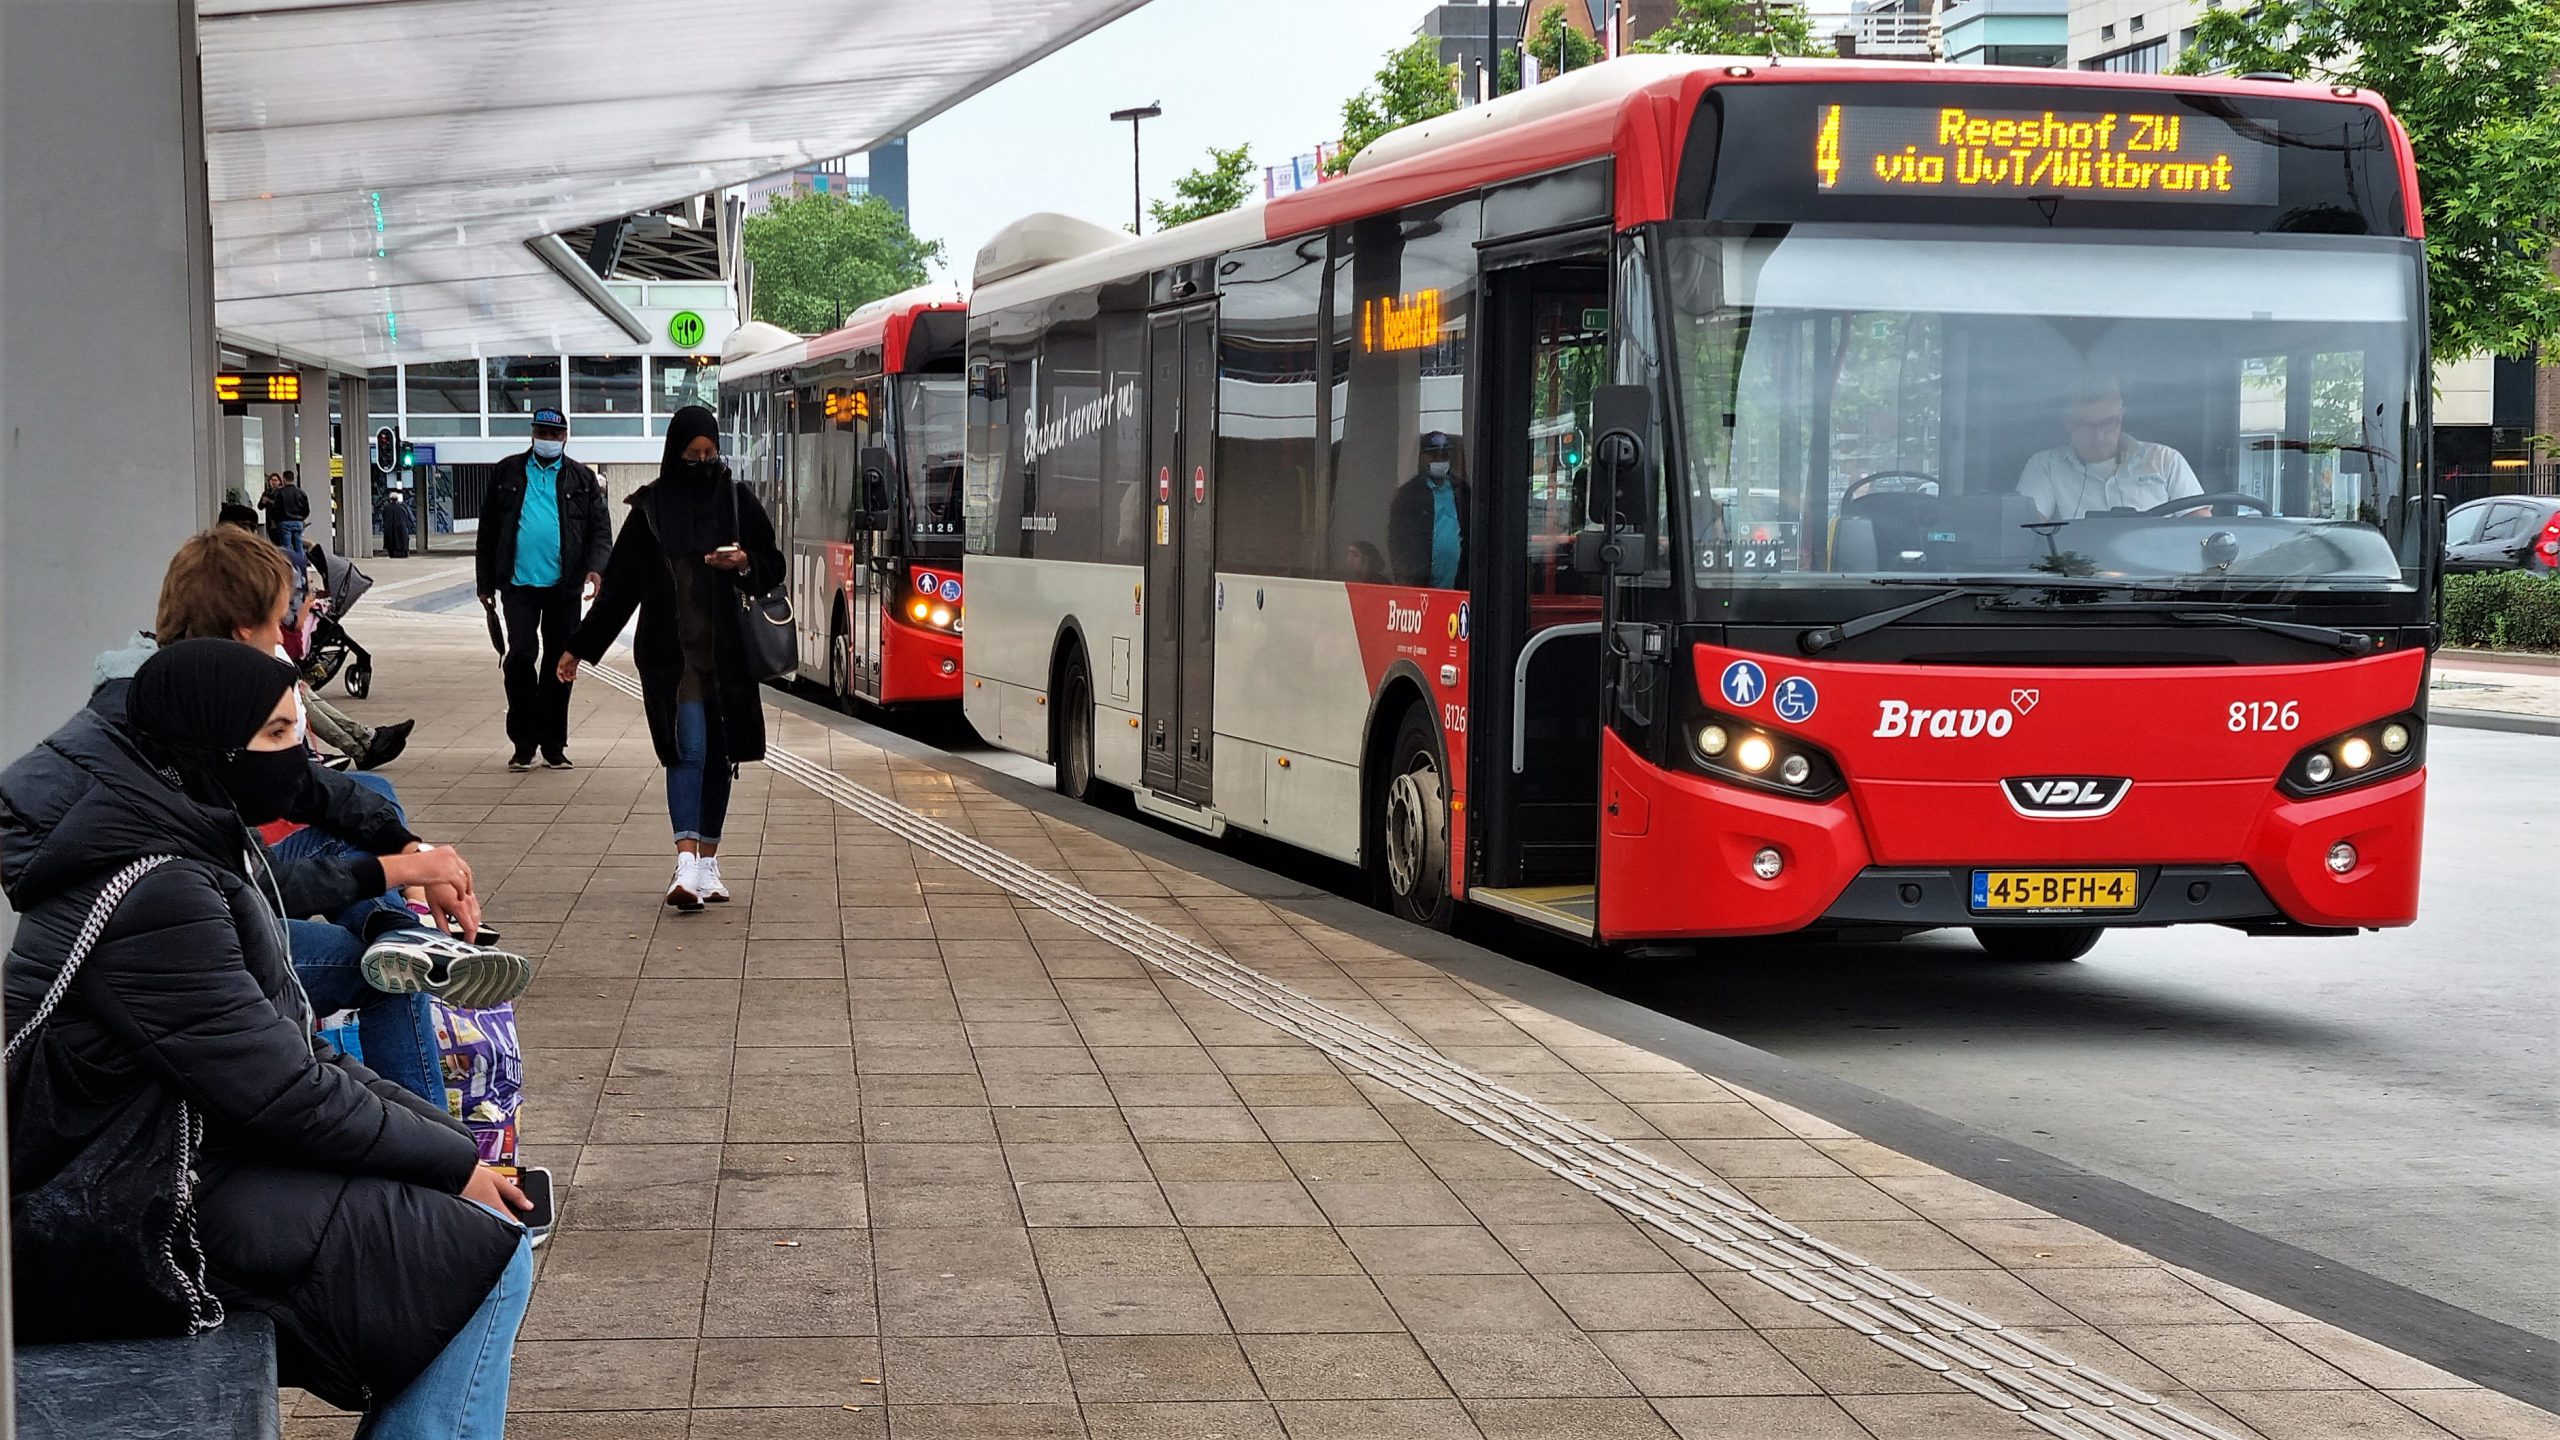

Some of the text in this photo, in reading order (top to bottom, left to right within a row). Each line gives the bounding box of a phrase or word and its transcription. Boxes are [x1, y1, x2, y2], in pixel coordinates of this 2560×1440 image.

[1816, 104, 1841, 188] 4
[1940, 108, 2180, 152] Reeshof ZW
[1876, 145, 2234, 192] via UvT/Witbrant
[1023, 371, 1135, 465] Brabant vervoert ons
[917, 523, 954, 533] 3125
[1702, 549, 1777, 568] 3124
[1386, 599, 1423, 635] Bravo
[1444, 703, 1466, 733] 8126
[1872, 699, 2014, 738] Bravo
[2227, 700, 2300, 732] 8126
[2021, 781, 2105, 805] VDL
[1974, 877, 2124, 904] NL 45-BFH-4
